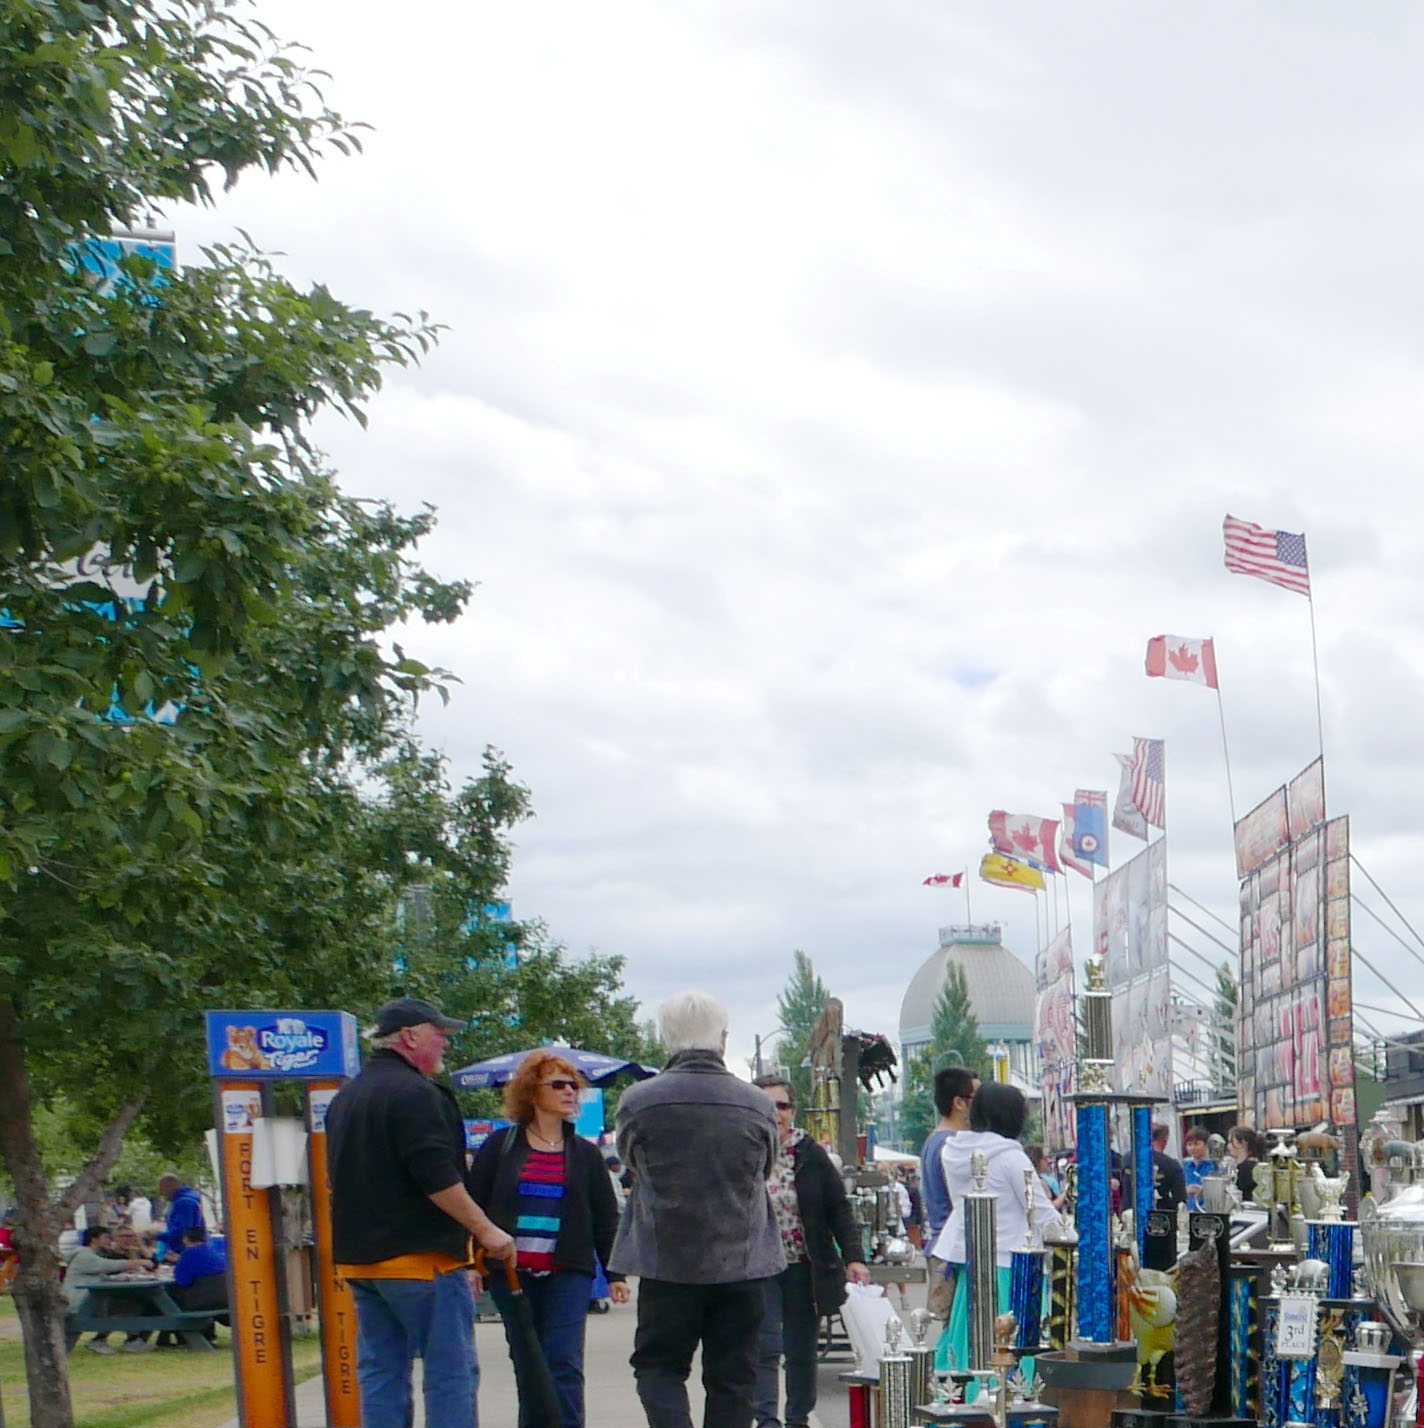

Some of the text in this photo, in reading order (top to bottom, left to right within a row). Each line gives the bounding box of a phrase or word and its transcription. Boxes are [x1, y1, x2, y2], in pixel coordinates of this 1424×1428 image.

[261, 1031, 324, 1051] Royale
[264, 1050, 319, 1071] Tiger
[246, 1230, 259, 1260] EN
[250, 1280, 267, 1364] TIGRE
[1287, 1324, 1305, 1344] 3rd
[336, 1311, 351, 1395] TIGRE
